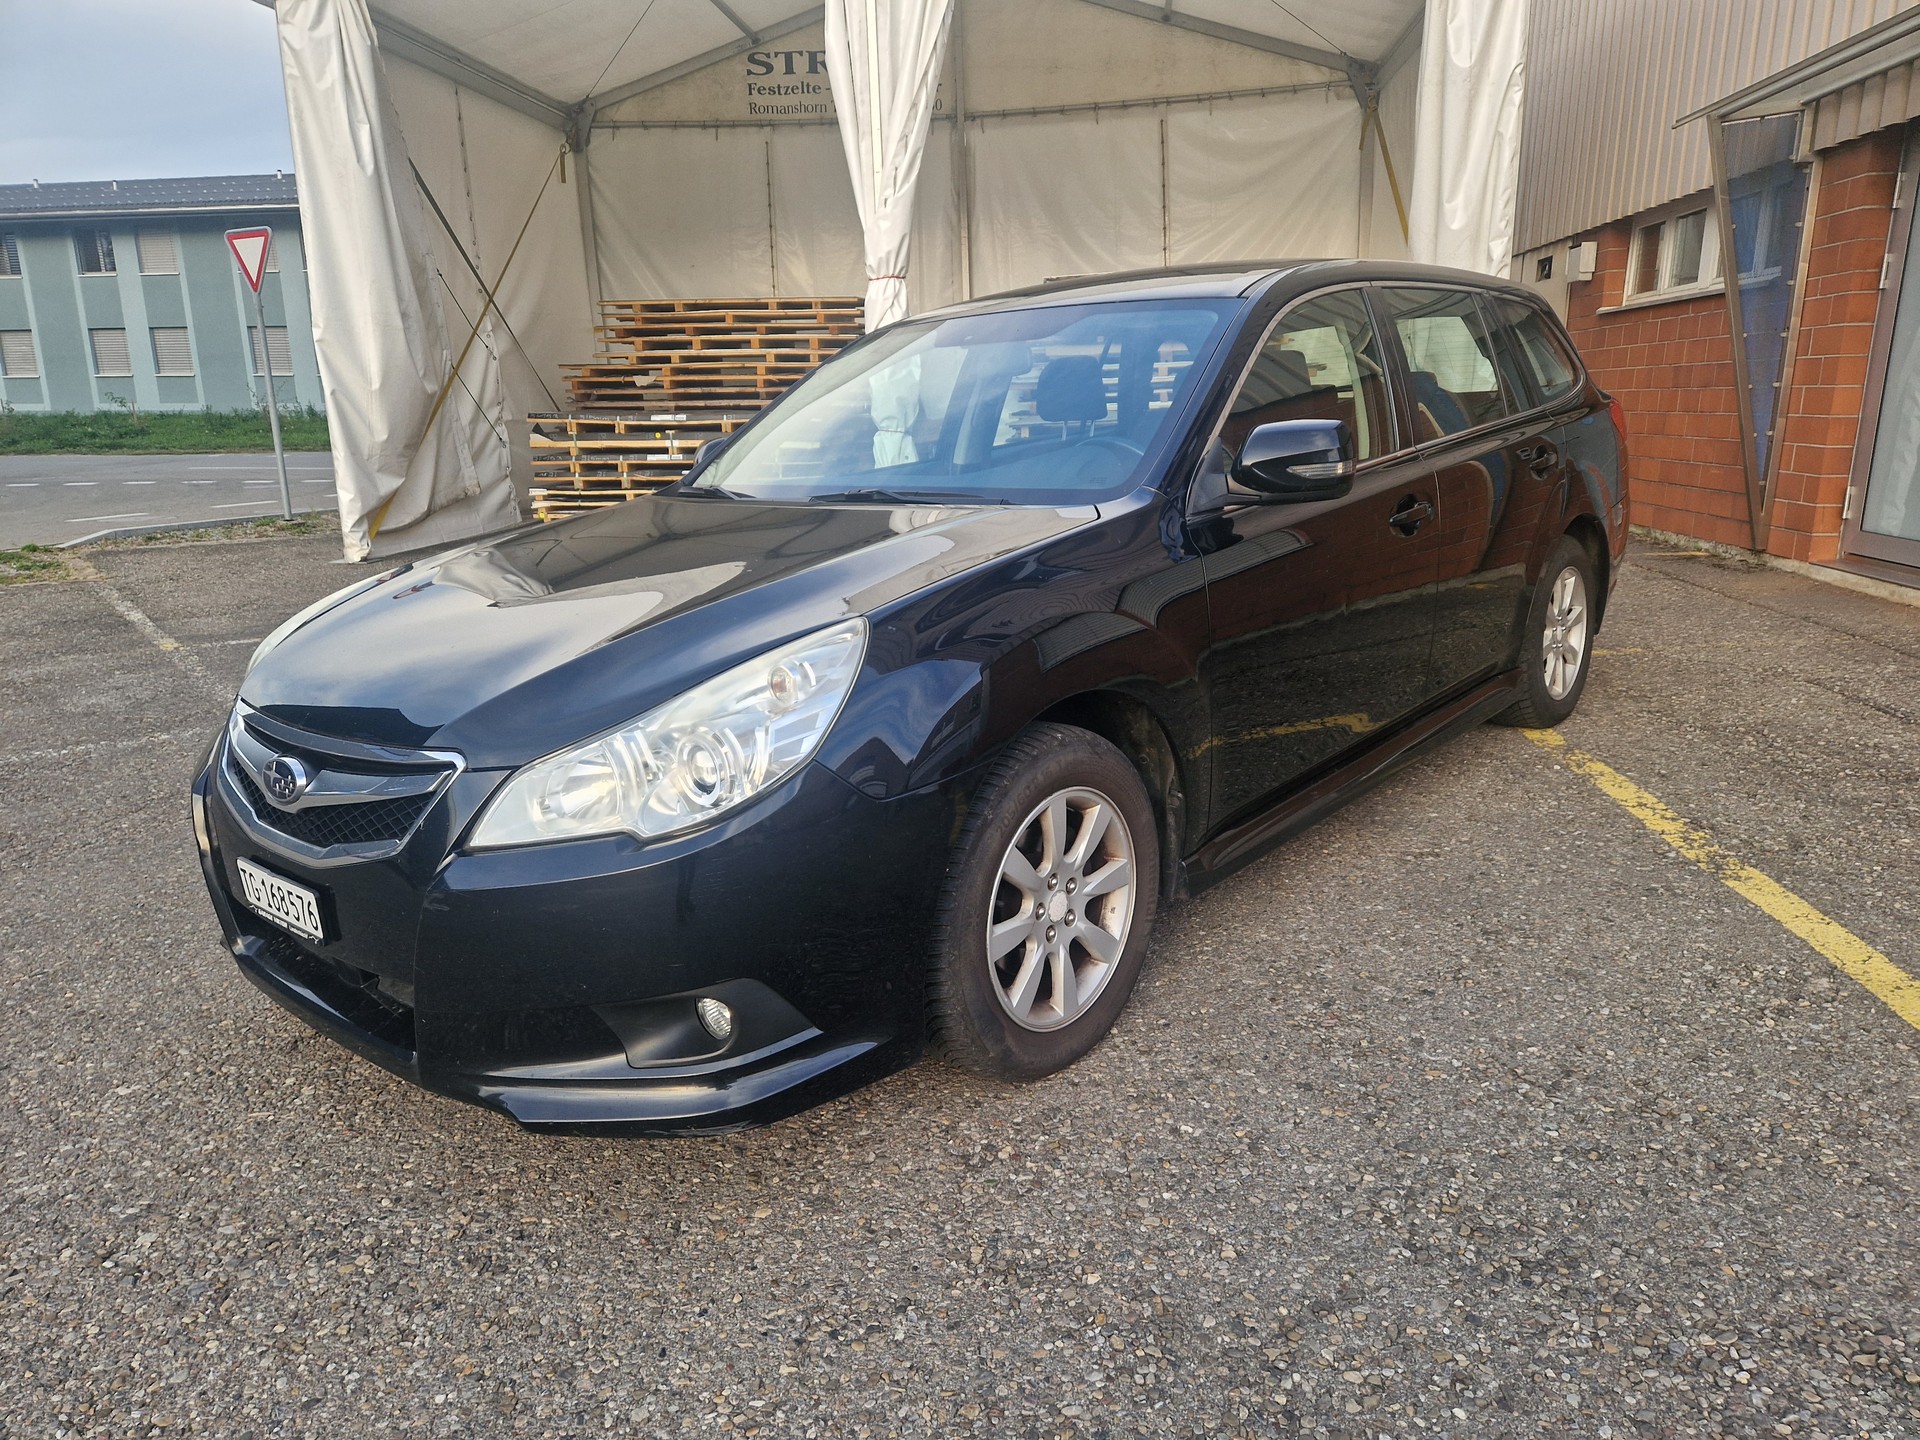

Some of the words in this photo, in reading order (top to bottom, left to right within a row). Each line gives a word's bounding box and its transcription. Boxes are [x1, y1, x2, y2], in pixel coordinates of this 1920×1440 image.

[746, 50, 828, 76] STR
[747, 81, 822, 96] Festzelte
[749, 101, 827, 115] Romanshorn
